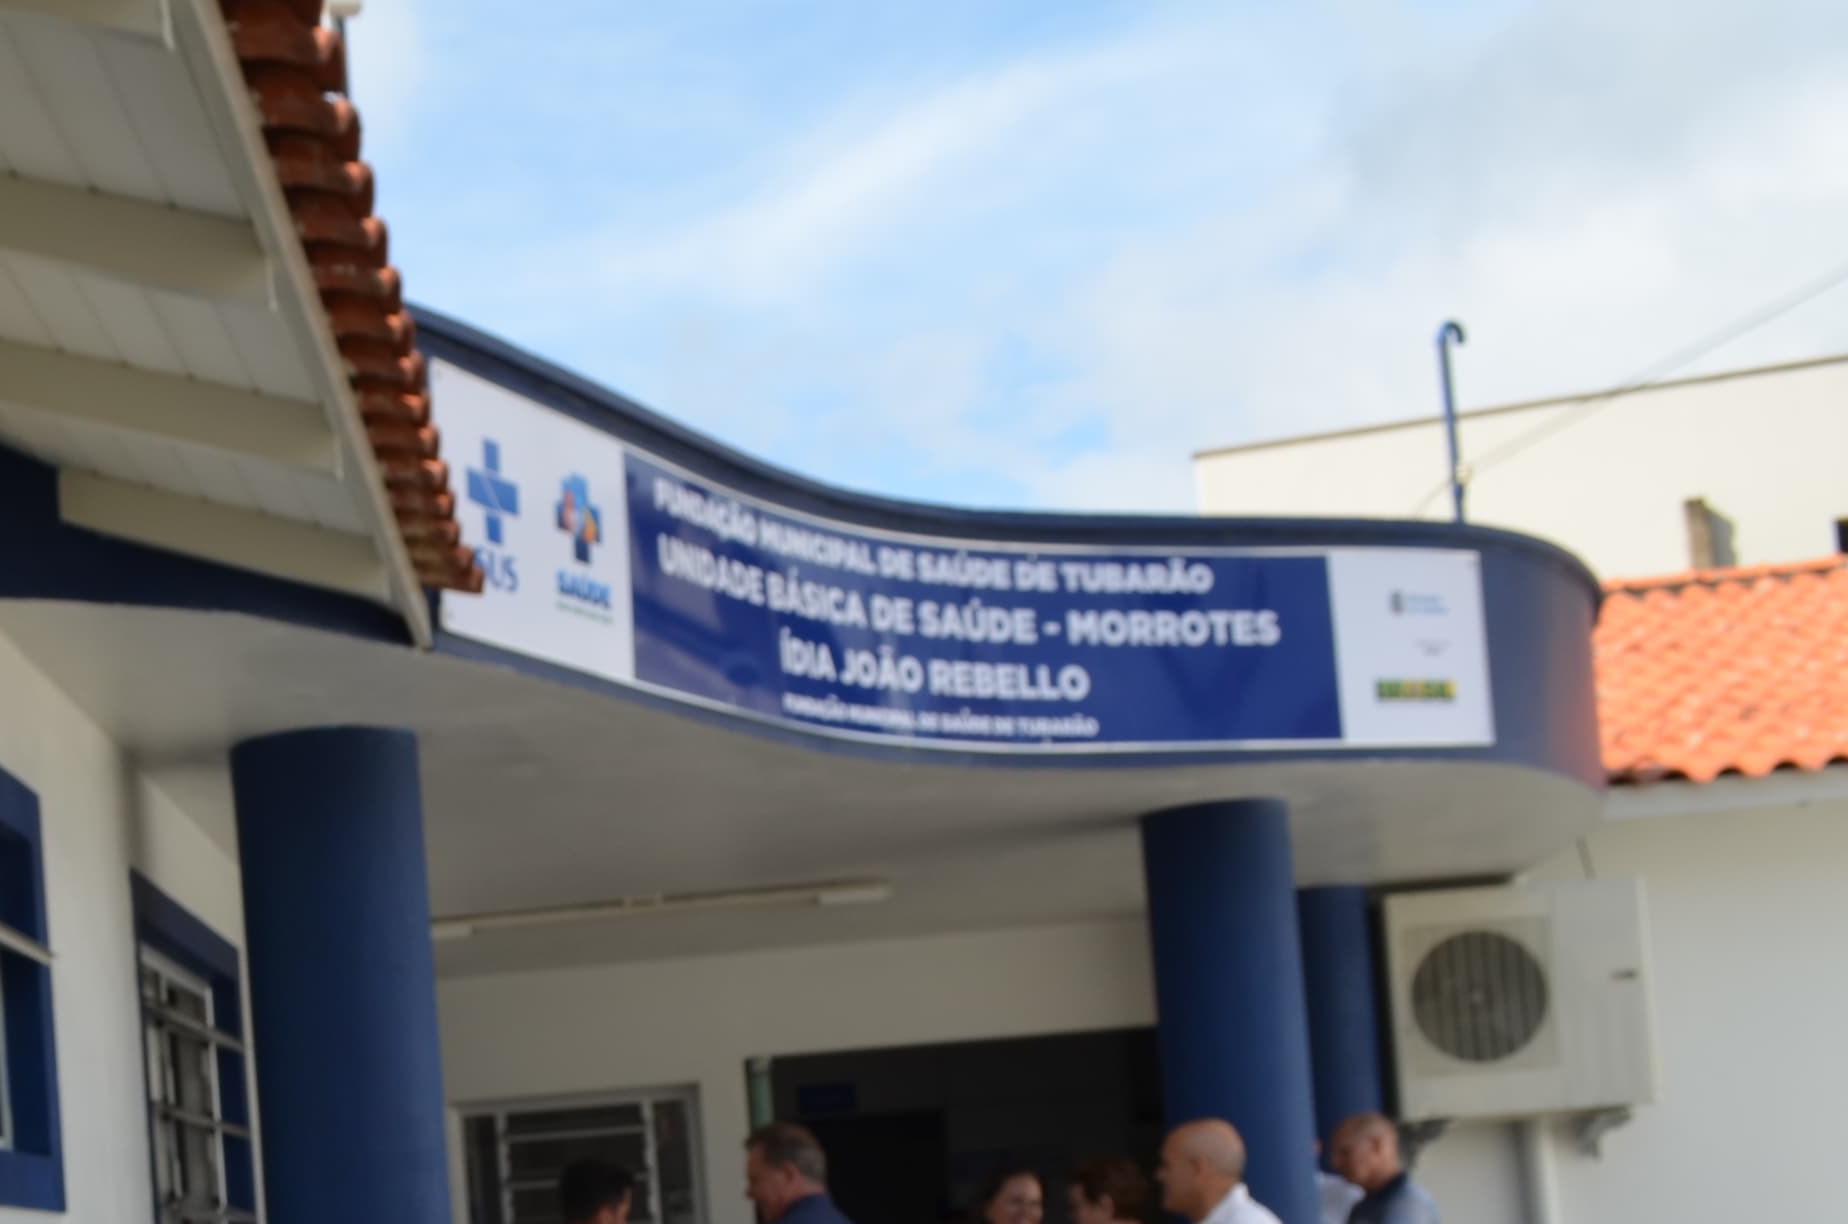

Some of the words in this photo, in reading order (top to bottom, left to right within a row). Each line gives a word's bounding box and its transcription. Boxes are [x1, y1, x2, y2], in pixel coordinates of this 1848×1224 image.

[657, 532, 765, 605] UNIDADE
[766, 566, 868, 628] BÁSICA
[870, 593, 914, 635] DE
[917, 596, 1039, 645] SAÚDE
[1065, 608, 1282, 647] MORROTES
[759, 518, 876, 575] MUNICIPAL
[878, 546, 914, 580] DE
[916, 550, 1011, 589] SAÚDE
[1015, 560, 1057, 592] DE
[1059, 556, 1214, 595] TUBARÃO
[779, 625, 837, 682] ÍDIA
[839, 645, 924, 694] JOÃO
[928, 659, 1092, 701] REBELLO
